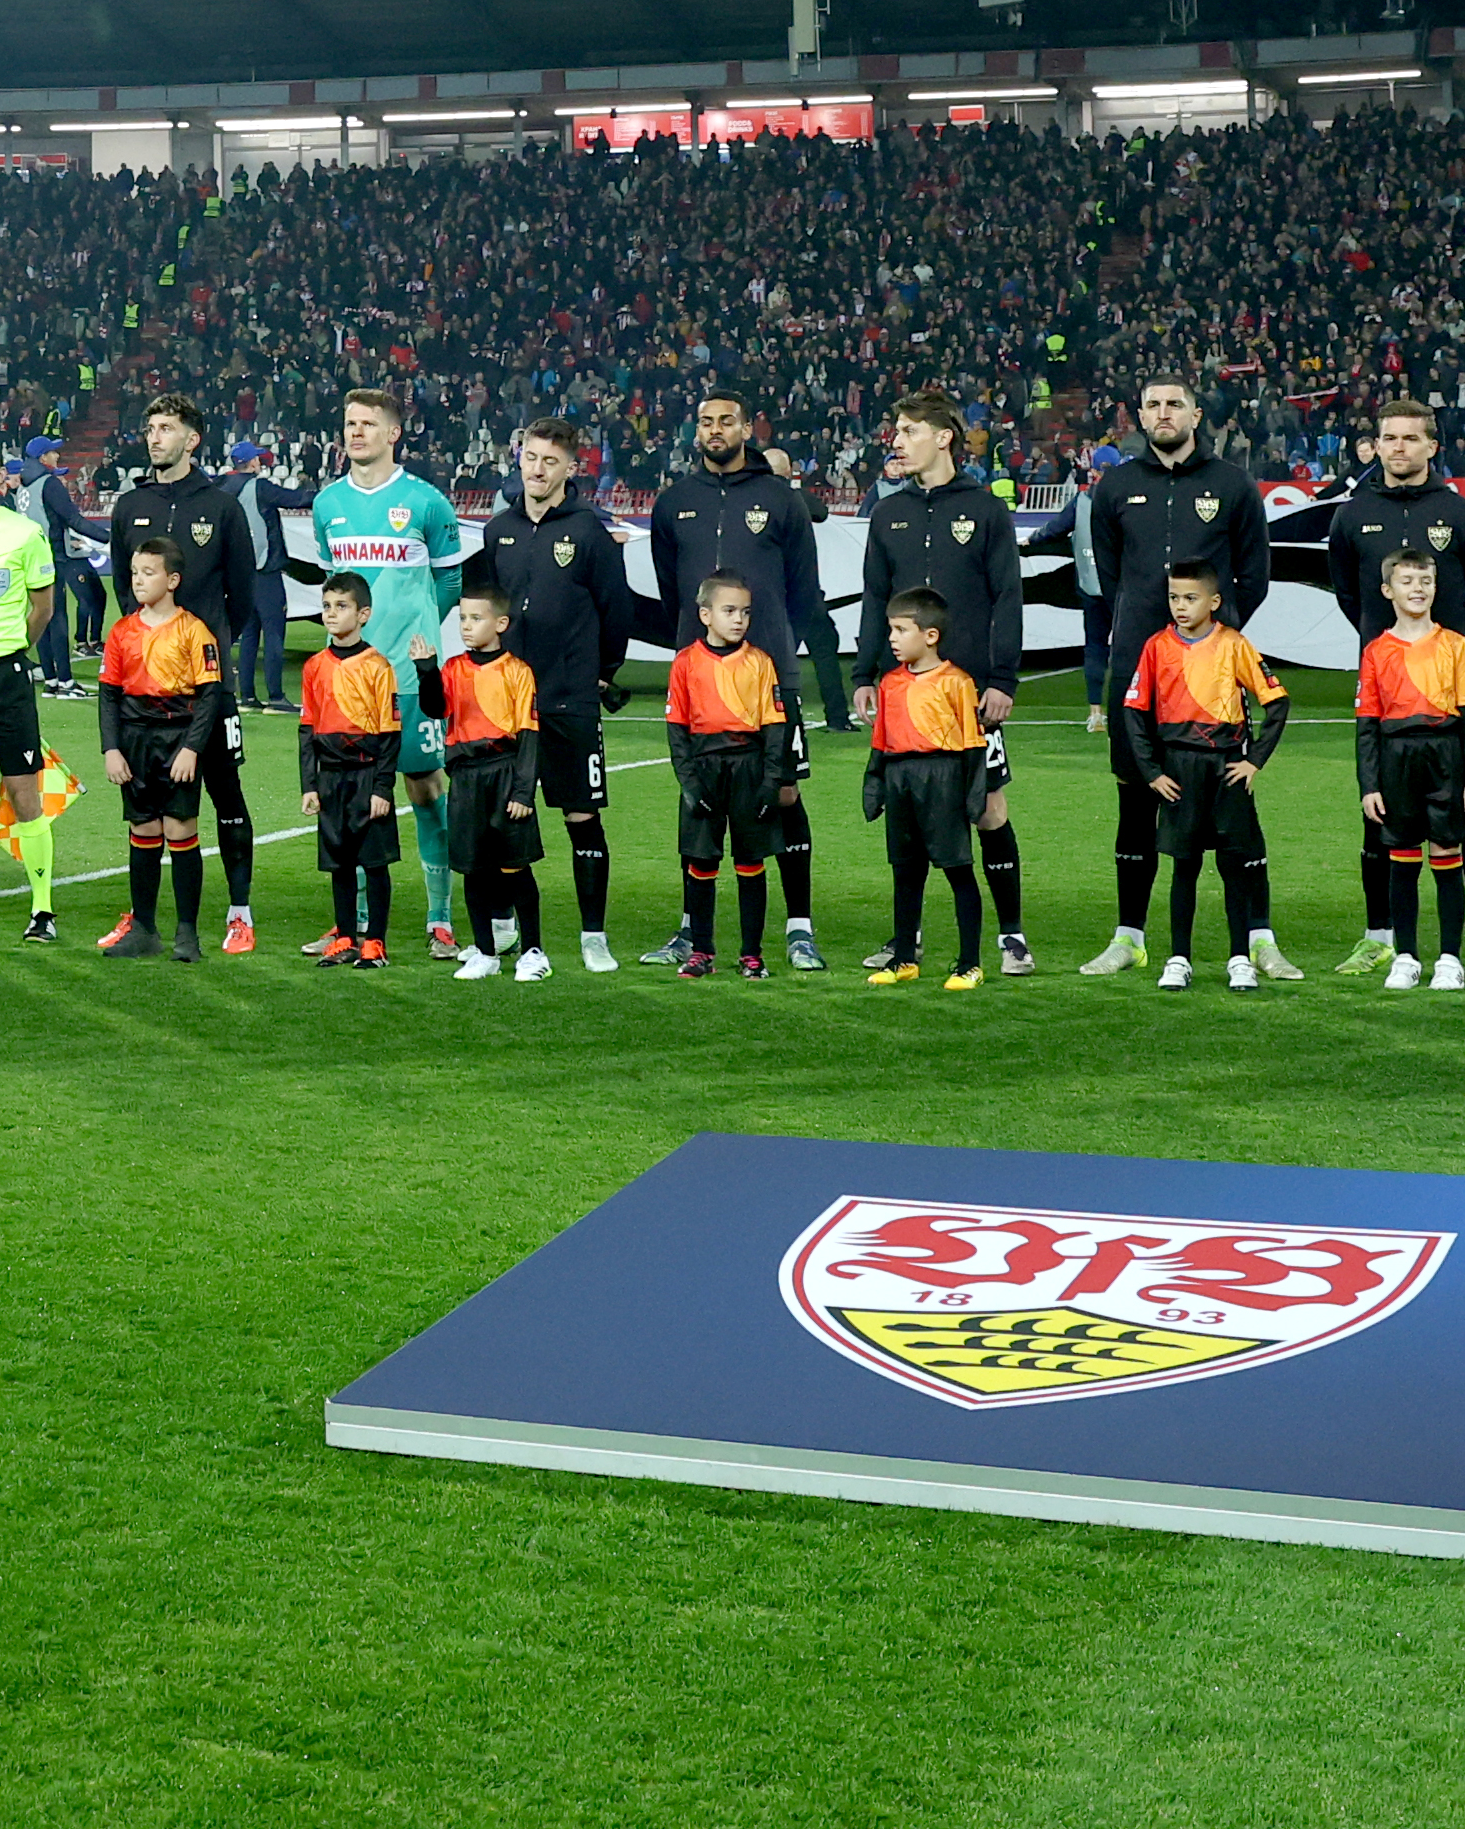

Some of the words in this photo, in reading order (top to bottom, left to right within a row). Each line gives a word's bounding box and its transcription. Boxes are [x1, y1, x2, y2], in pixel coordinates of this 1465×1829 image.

[330, 543, 409, 562] WINAMAX
[224, 715, 241, 749] 16
[418, 719, 444, 753] 33
[791, 724, 804, 759] 4
[985, 729, 1006, 769] 29
[588, 753, 601, 788] 6
[909, 1290, 974, 1308] 18
[1154, 1306, 1227, 1326] 93
